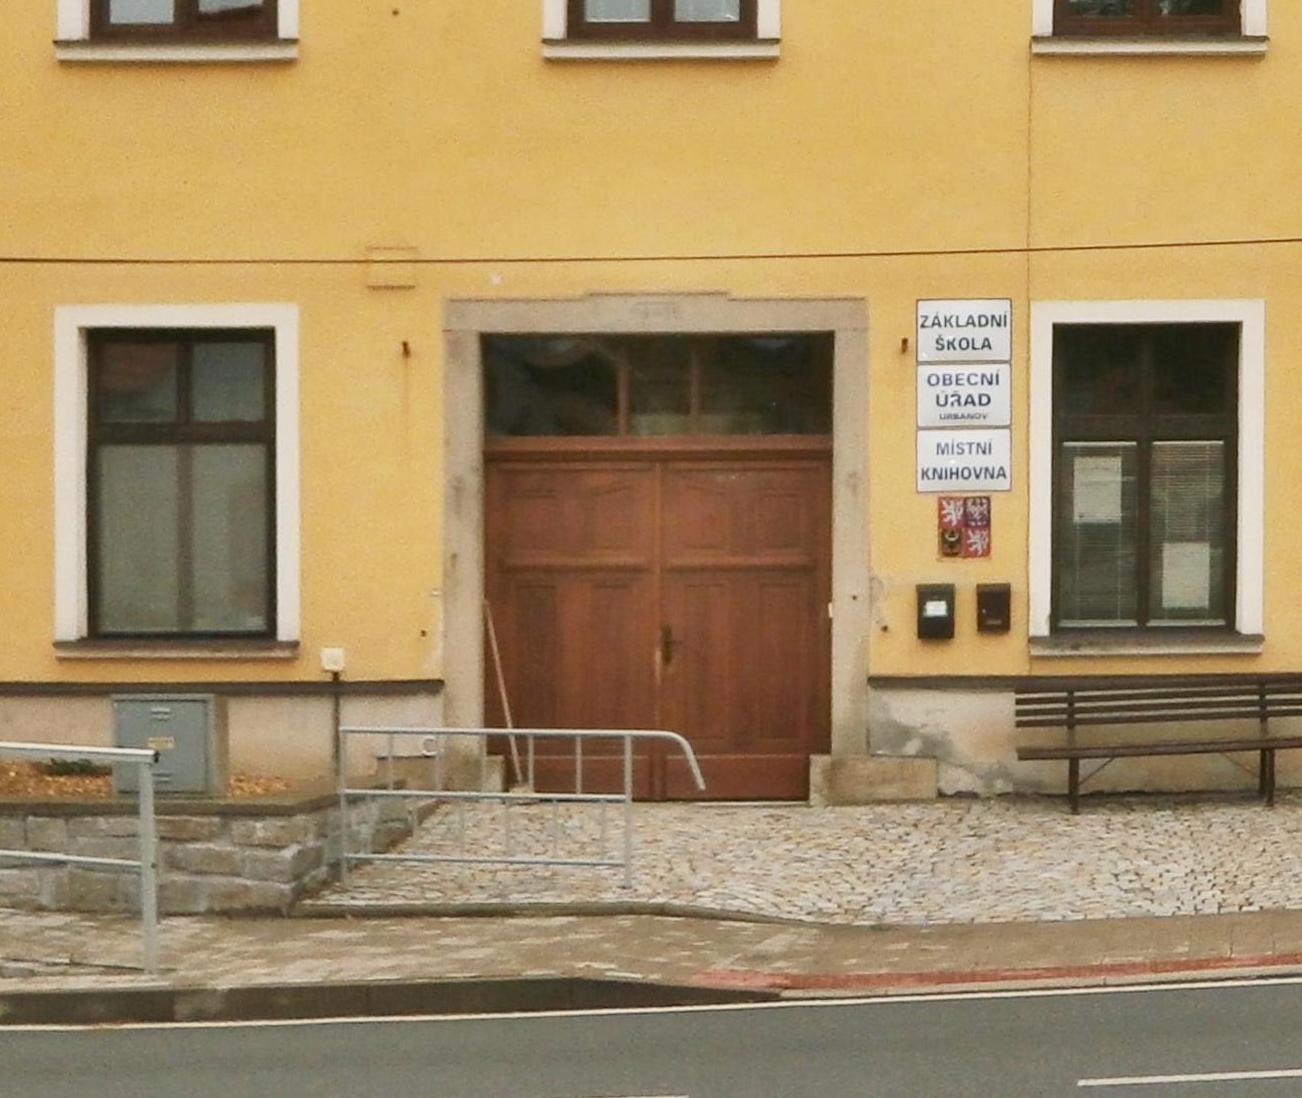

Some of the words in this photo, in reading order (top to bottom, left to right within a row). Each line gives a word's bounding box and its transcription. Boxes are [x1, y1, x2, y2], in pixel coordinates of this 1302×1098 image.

[920, 311, 1008, 328] ZÁKLADNÍ
[935, 334, 992, 351] ŠKOLA
[927, 369, 1000, 386] OBECNÍ
[935, 390, 991, 407] ÚŘAD
[936, 438, 993, 455] MÍSTNÍ
[921, 466, 1007, 480] KNIHOVNA
